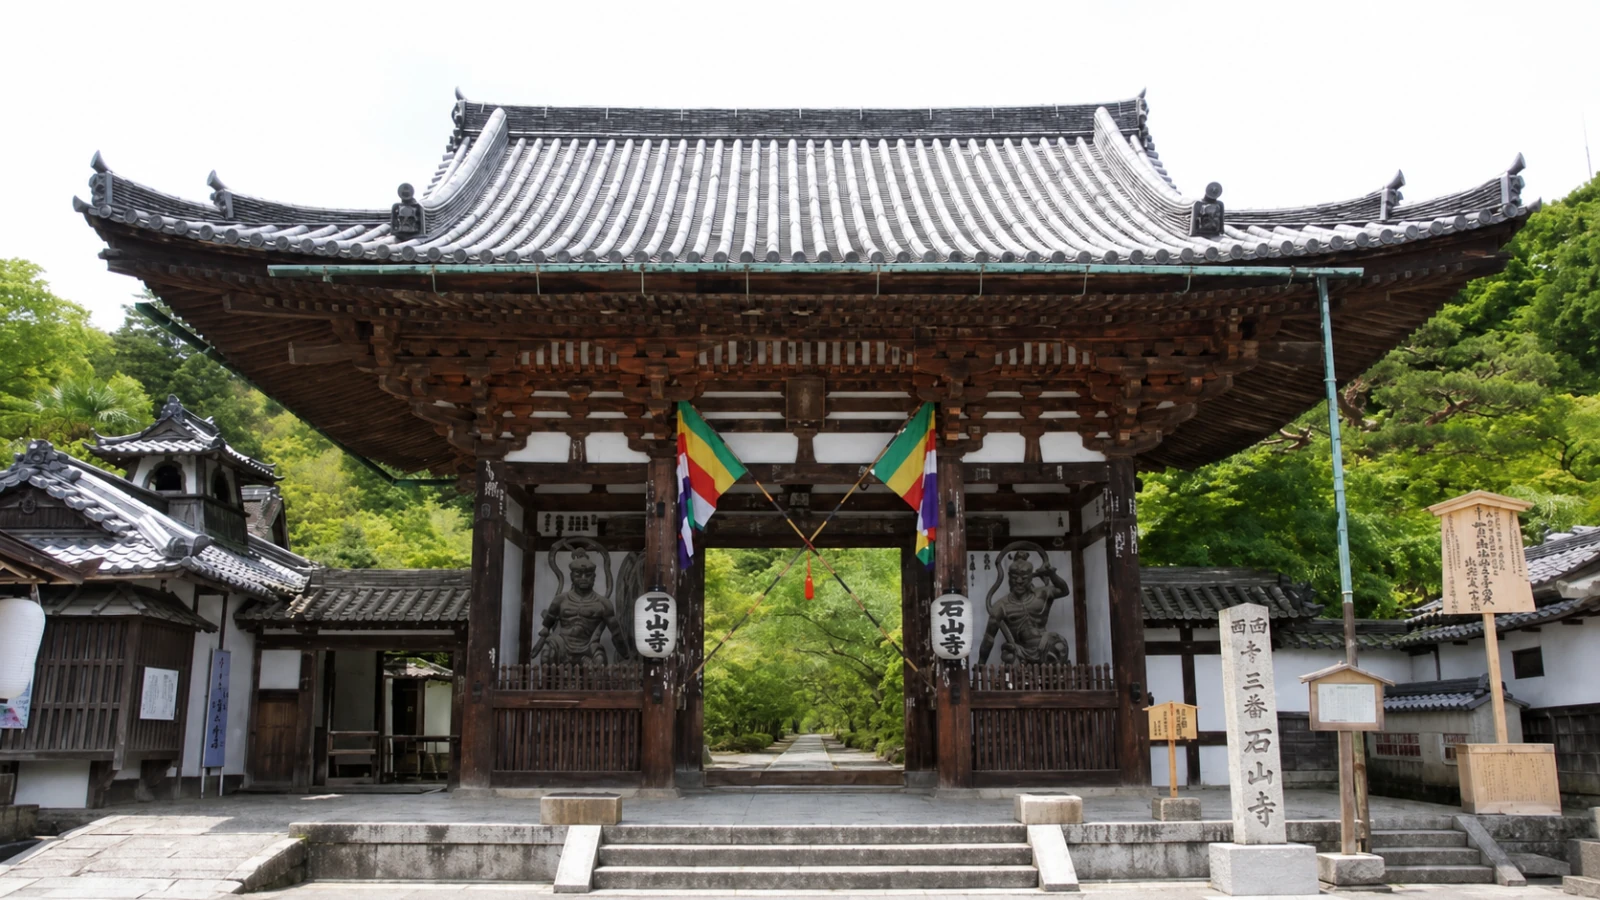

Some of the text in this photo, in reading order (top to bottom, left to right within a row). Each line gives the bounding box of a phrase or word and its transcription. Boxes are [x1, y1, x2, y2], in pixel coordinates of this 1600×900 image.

[645, 597, 670, 653] 石山寺
[938, 600, 965, 656] 石山寺
